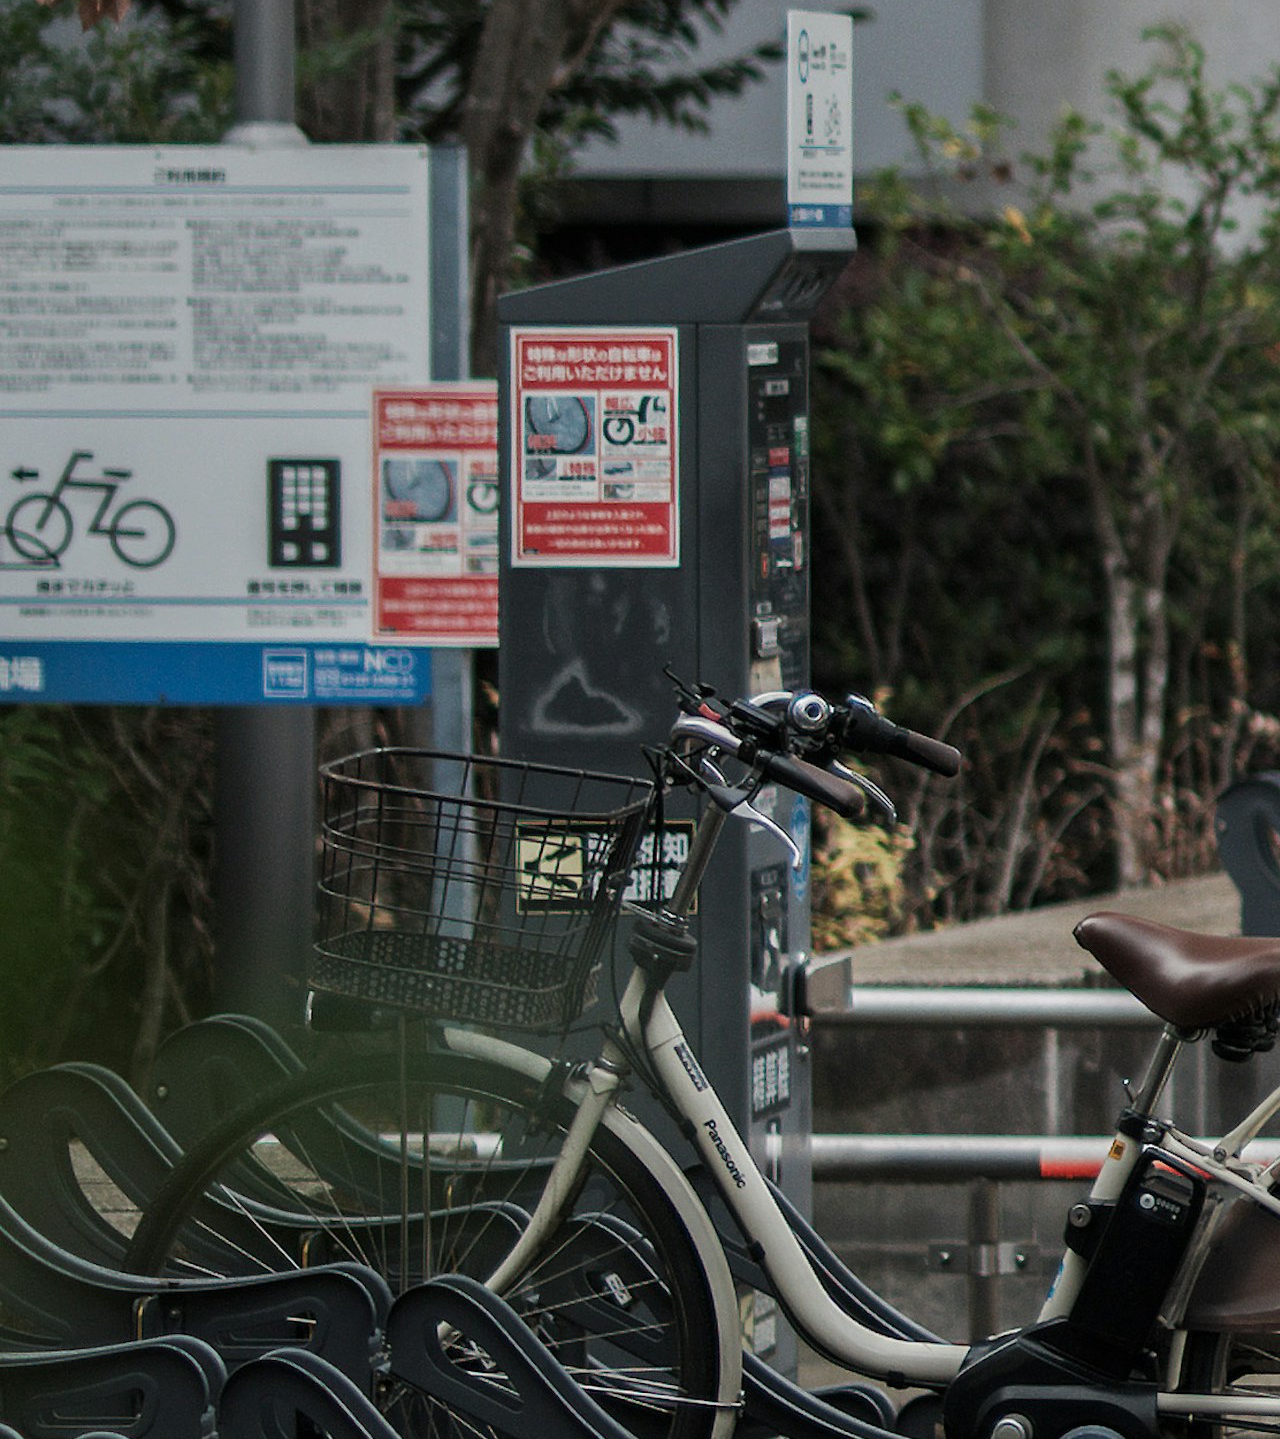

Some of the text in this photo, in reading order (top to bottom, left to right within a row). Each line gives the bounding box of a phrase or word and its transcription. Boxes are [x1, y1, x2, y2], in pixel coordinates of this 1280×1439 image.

[524, 364, 667, 382] ご利用いただけません
[703, 1119, 746, 1189] Panasonic
